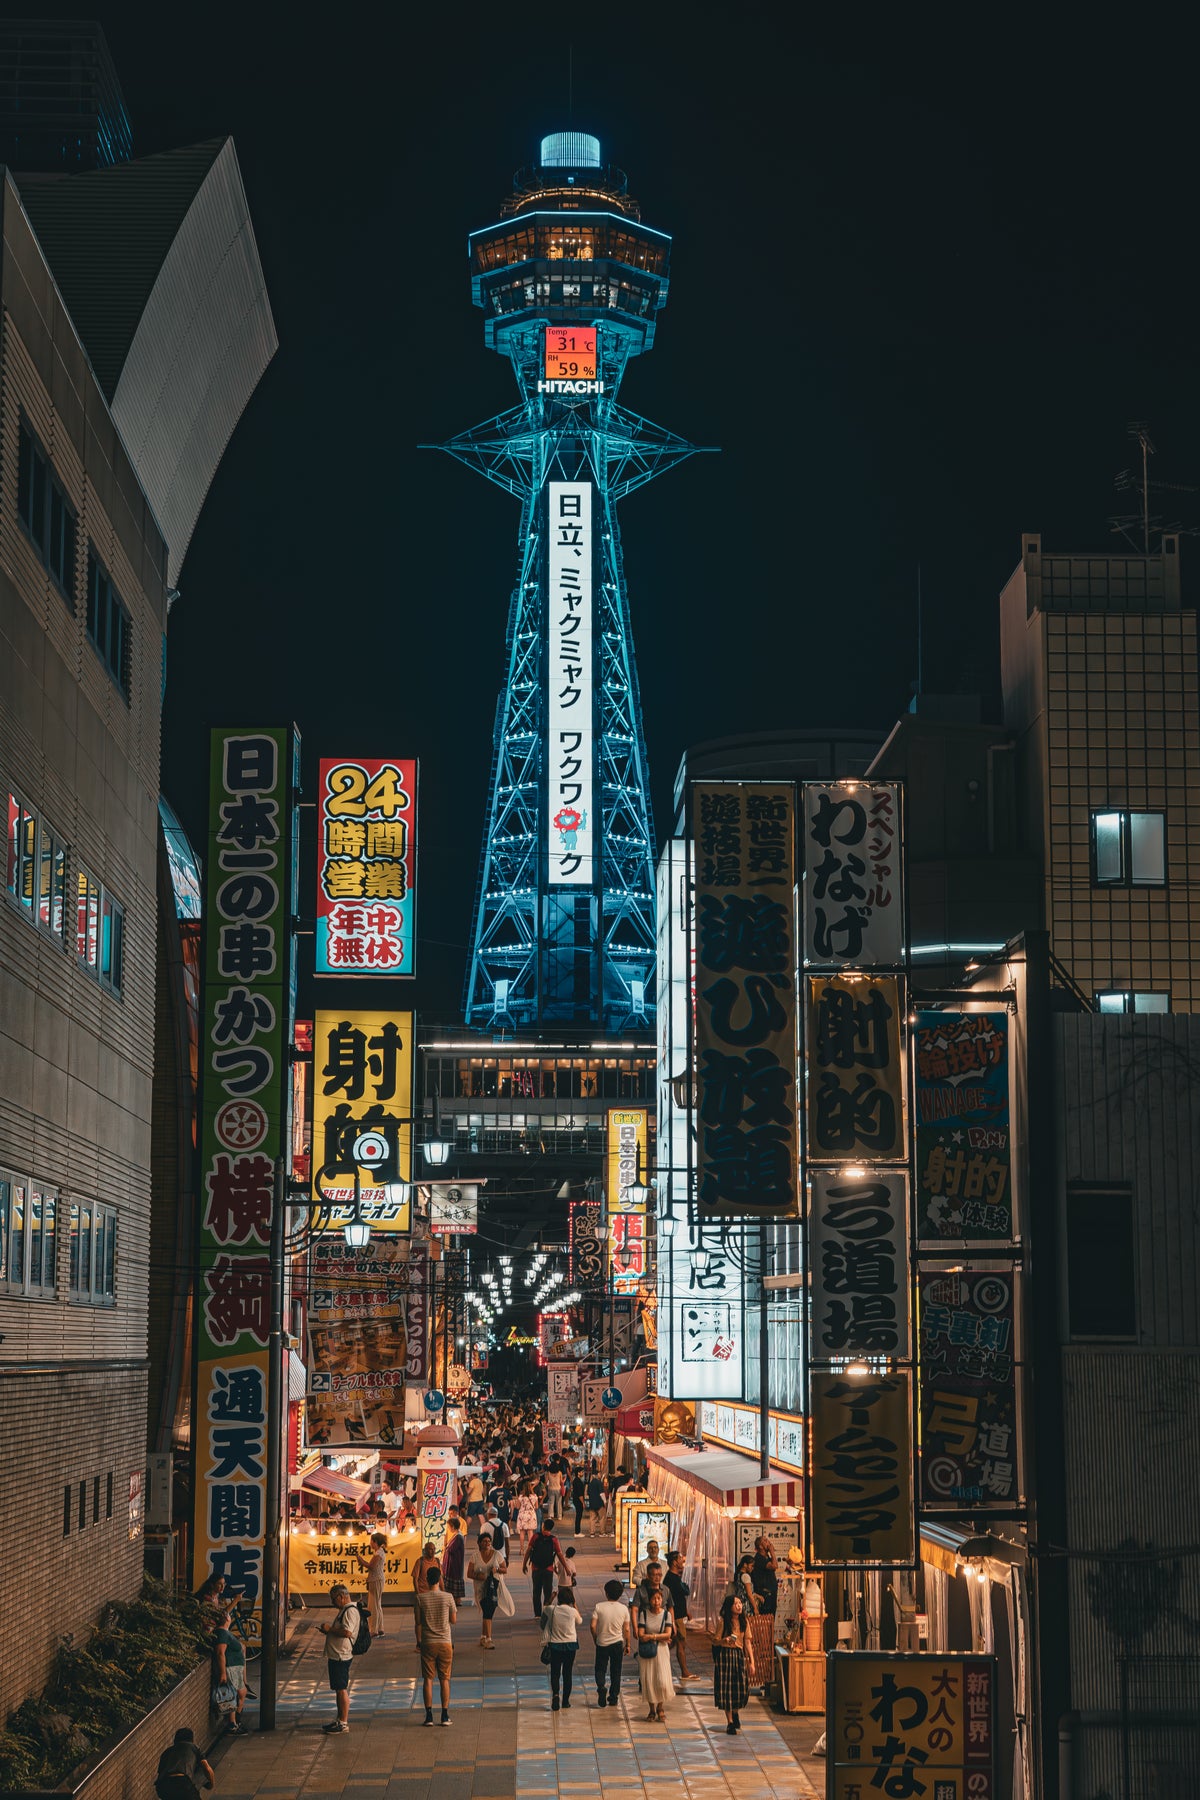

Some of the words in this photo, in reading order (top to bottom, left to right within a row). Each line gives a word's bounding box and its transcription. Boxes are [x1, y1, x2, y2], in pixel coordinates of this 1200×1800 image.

[547, 328, 568, 337] Temp
[558, 337, 577, 351] 31
[547, 354, 559, 362] RH
[558, 362, 578, 376] 59
[583, 366, 595, 376] %
[537, 380, 604, 394] HITACHI
[557, 494, 583, 709] 日立、ミャクミャク
[325, 766, 409, 818] 24
[325, 820, 406, 858] 時間
[700, 794, 742, 886] 遊技場
[747, 795, 788, 886] 新世界一
[868, 791, 894, 908] スペシャル
[323, 860, 406, 899] 営業
[811, 793, 872, 959] わなげ
[213, 735, 279, 1097] 日本一の串かつ
[328, 905, 402, 937] 年中
[328, 935, 402, 967] 無休
[918, 1016, 992, 1046] スペシャル
[817, 988, 892, 1152] 射的
[918, 1031, 1004, 1081] 輪投げ
[322, 1021, 402, 1183] 射的
[918, 1088, 986, 1123] WANAGE
[968, 1127, 1006, 1149] PAN!
[922, 1146, 1008, 1205] 射的
[961, 1201, 1009, 1232] 体験
[204, 1153, 271, 1347] 横綱
[316, 1244, 357, 1258] 新世界
[922, 1306, 1011, 1353] 手裏剣
[927, 1391, 979, 1456] 弓
[820, 1380, 900, 1555] ゲームセンター
[978, 1420, 1013, 1497] 道場
[304, 1559, 408, 1574] 令和版「わげ」
[317, 1542, 395, 1556] 振り返れ、
[928, 1669, 959, 1752] 大人の
[870, 1673, 929, 1799] わな
